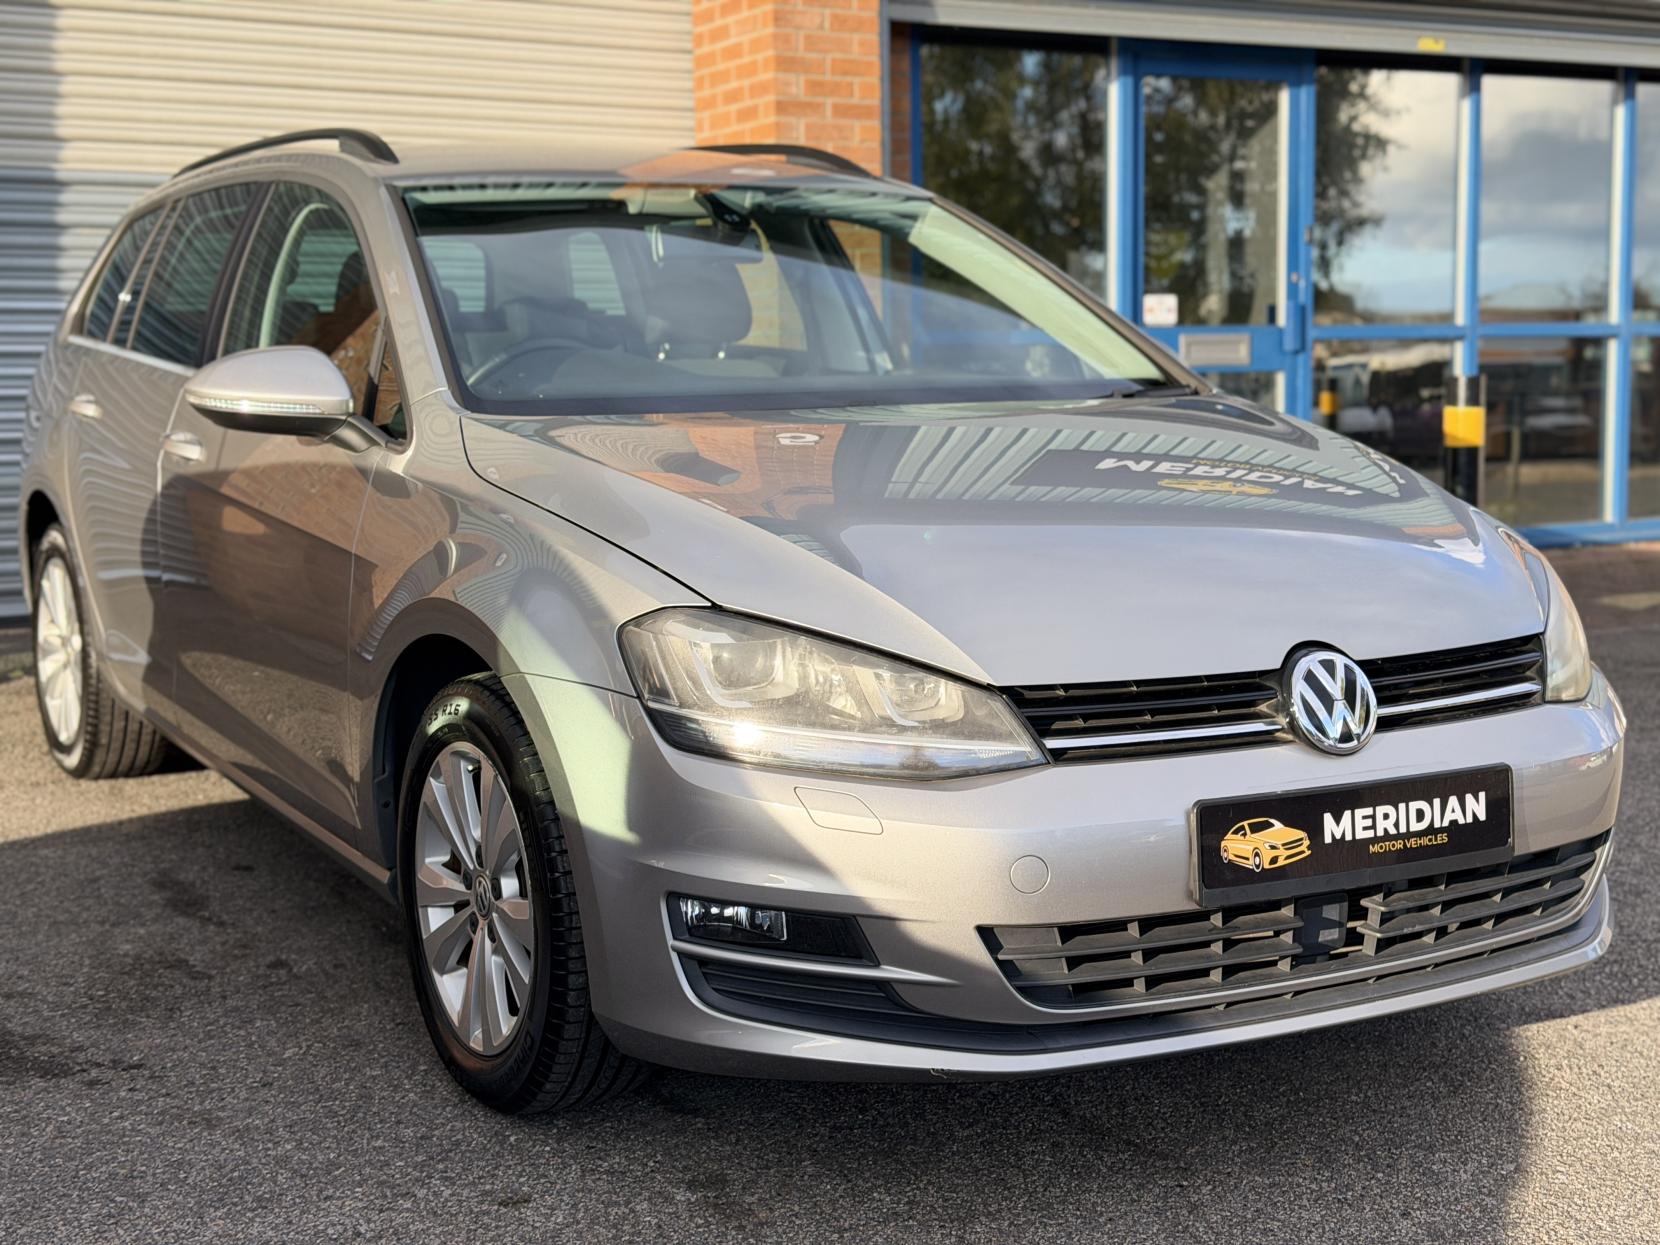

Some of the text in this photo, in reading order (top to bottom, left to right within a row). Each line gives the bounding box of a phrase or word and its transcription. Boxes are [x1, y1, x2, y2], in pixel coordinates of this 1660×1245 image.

[442, 703, 460, 716] R16
[1324, 791, 1487, 844] MERIDIAN
[1369, 832, 1449, 855] MOTOR VEHICLES
